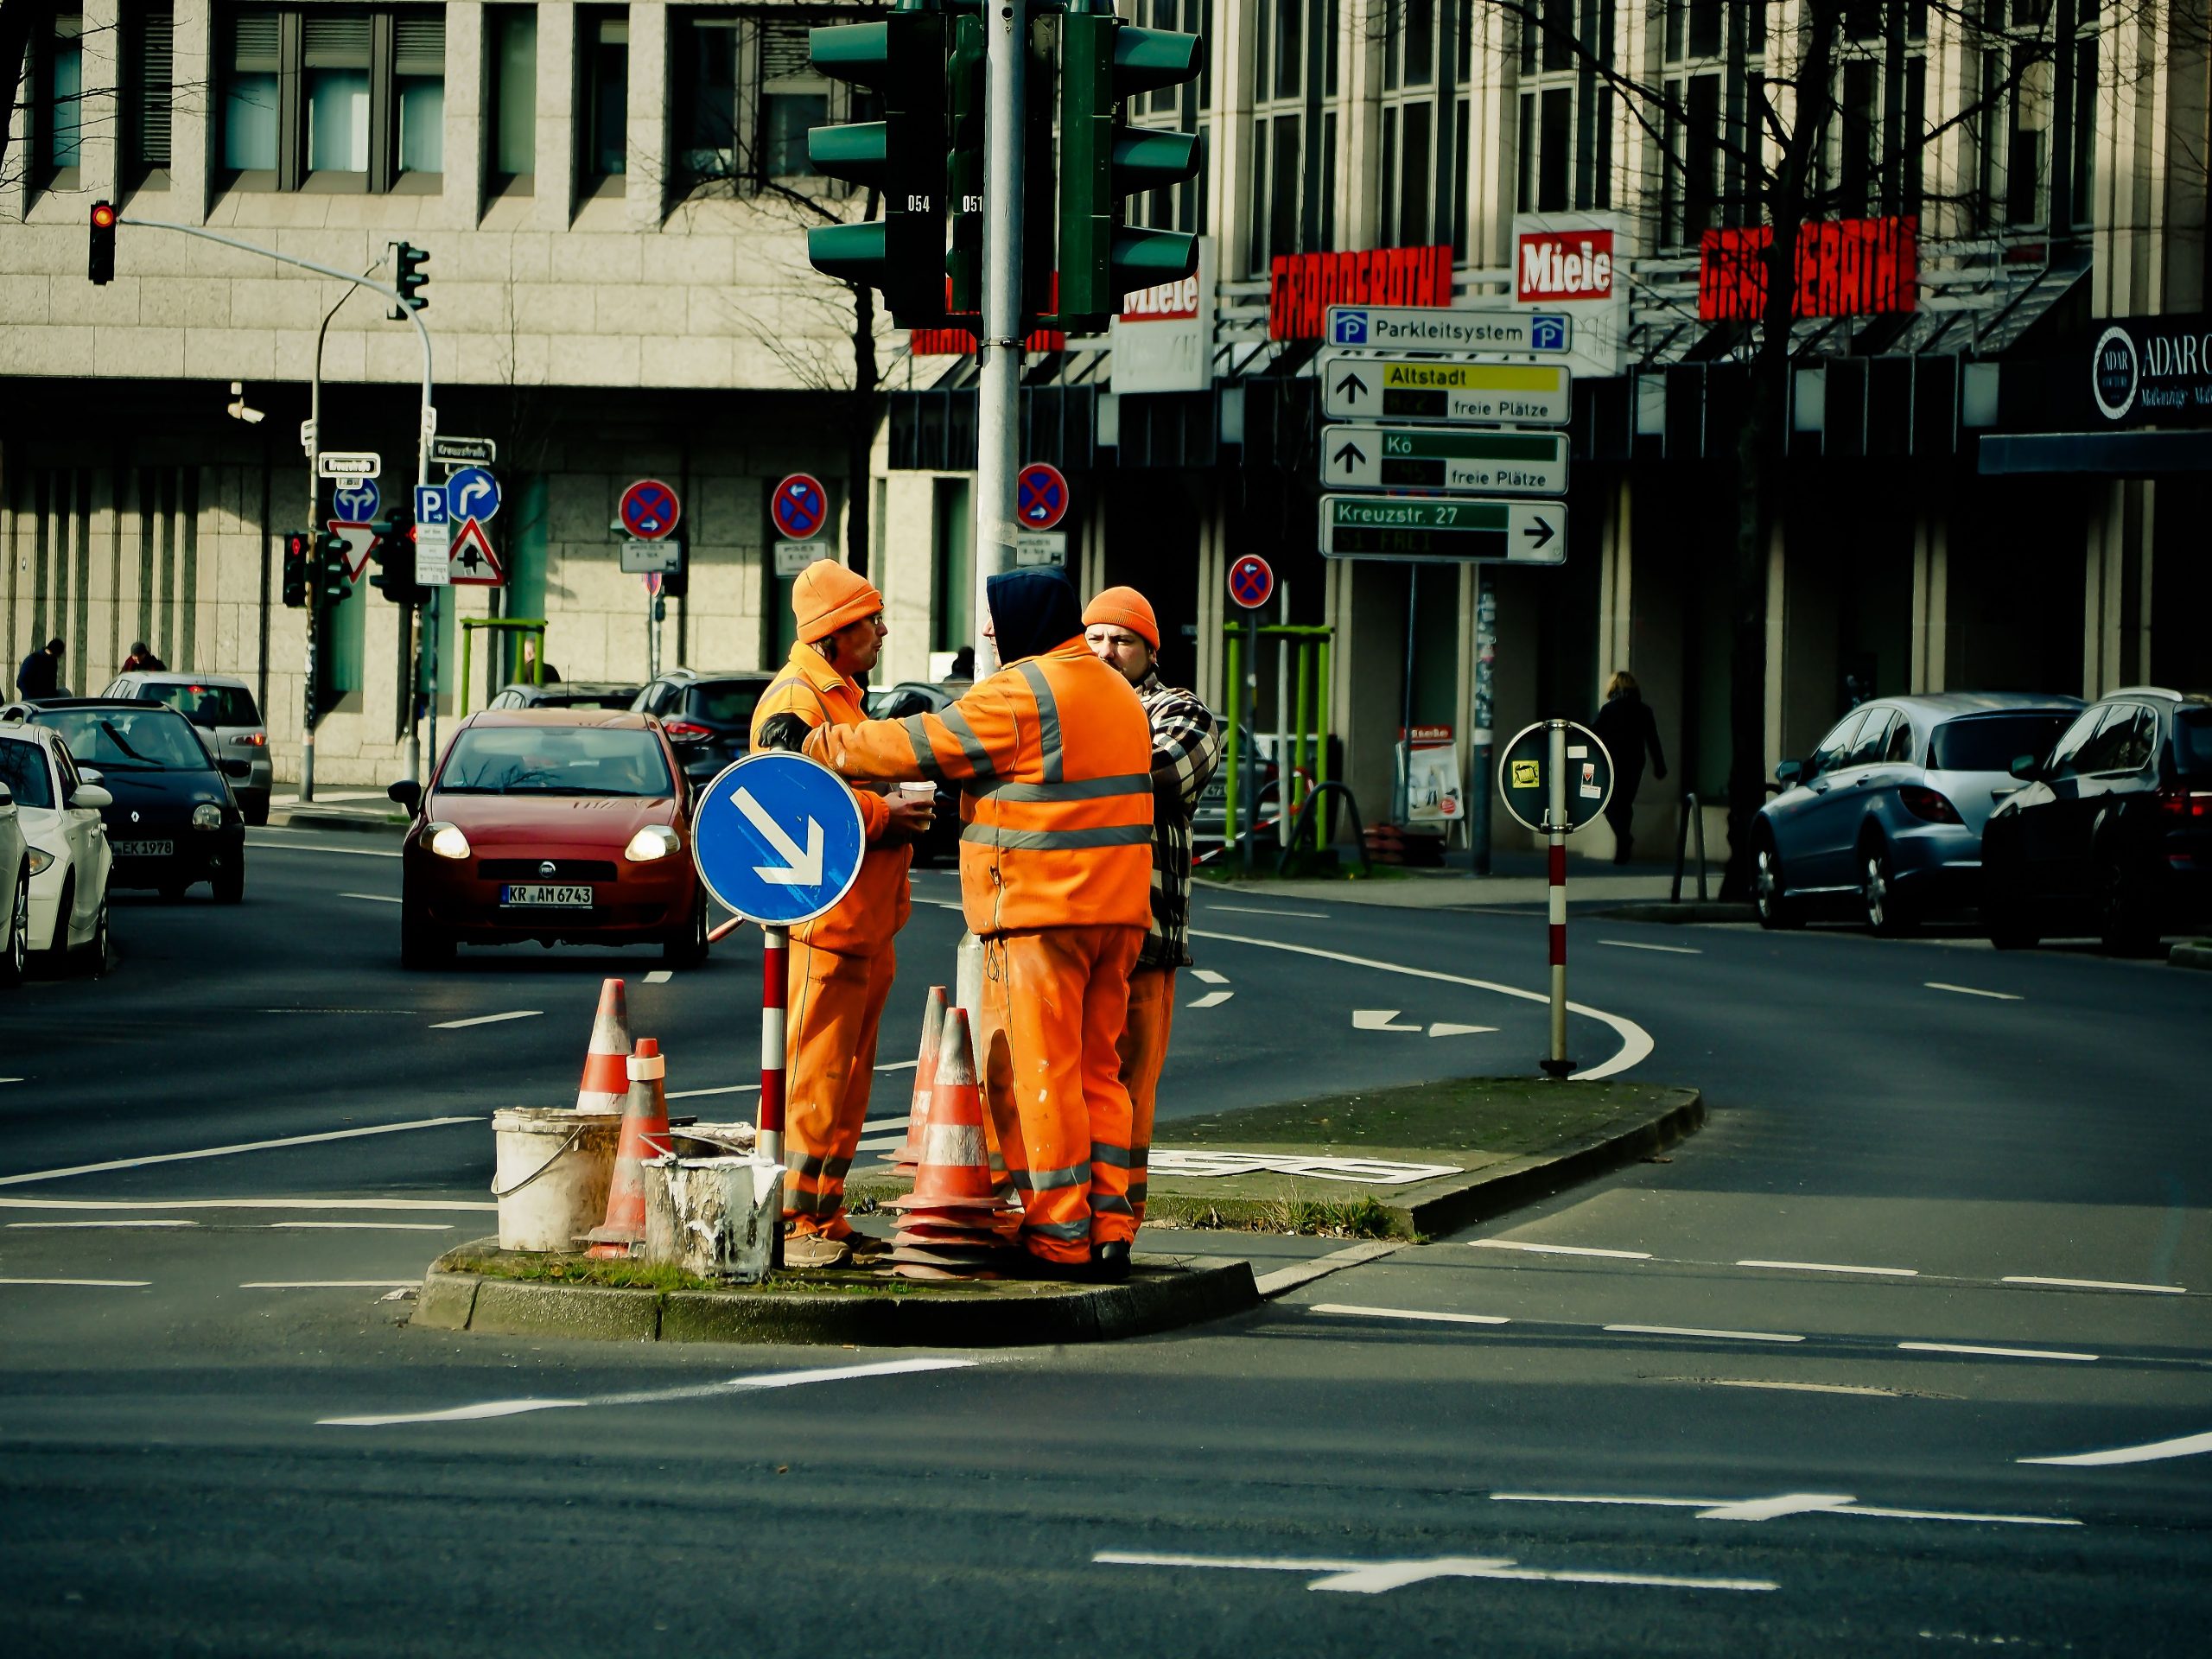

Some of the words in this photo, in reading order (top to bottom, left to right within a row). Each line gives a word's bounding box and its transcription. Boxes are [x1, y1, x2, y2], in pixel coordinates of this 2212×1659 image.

[907, 194, 931, 213] 054
[963, 195, 982, 213] 051
[1521, 241, 1611, 295] Miele
[1700, 216, 1897, 321] GRAERATH
[1376, 320, 1523, 343] Parkleitsystem
[2104, 351, 2128, 371] ADAR
[2143, 334, 2197, 376] ADAR
[1390, 366, 1467, 386] Altstadt
[1454, 401, 1491, 416] freie
[1499, 402, 1548, 417] Plätze
[1387, 436, 1412, 454] Kö
[1452, 470, 1490, 485] freie
[1497, 471, 1547, 487] Plätze
[423, 490, 442, 522] P
[1339, 505, 1425, 524] Kreuzstr.
[1436, 507, 1458, 524] 27
[122, 842, 138, 855] EK
[142, 842, 172, 855] 1978
[509, 887, 526, 902] KR
[537, 888, 555, 903] AM
[556, 888, 591, 904] 6743
